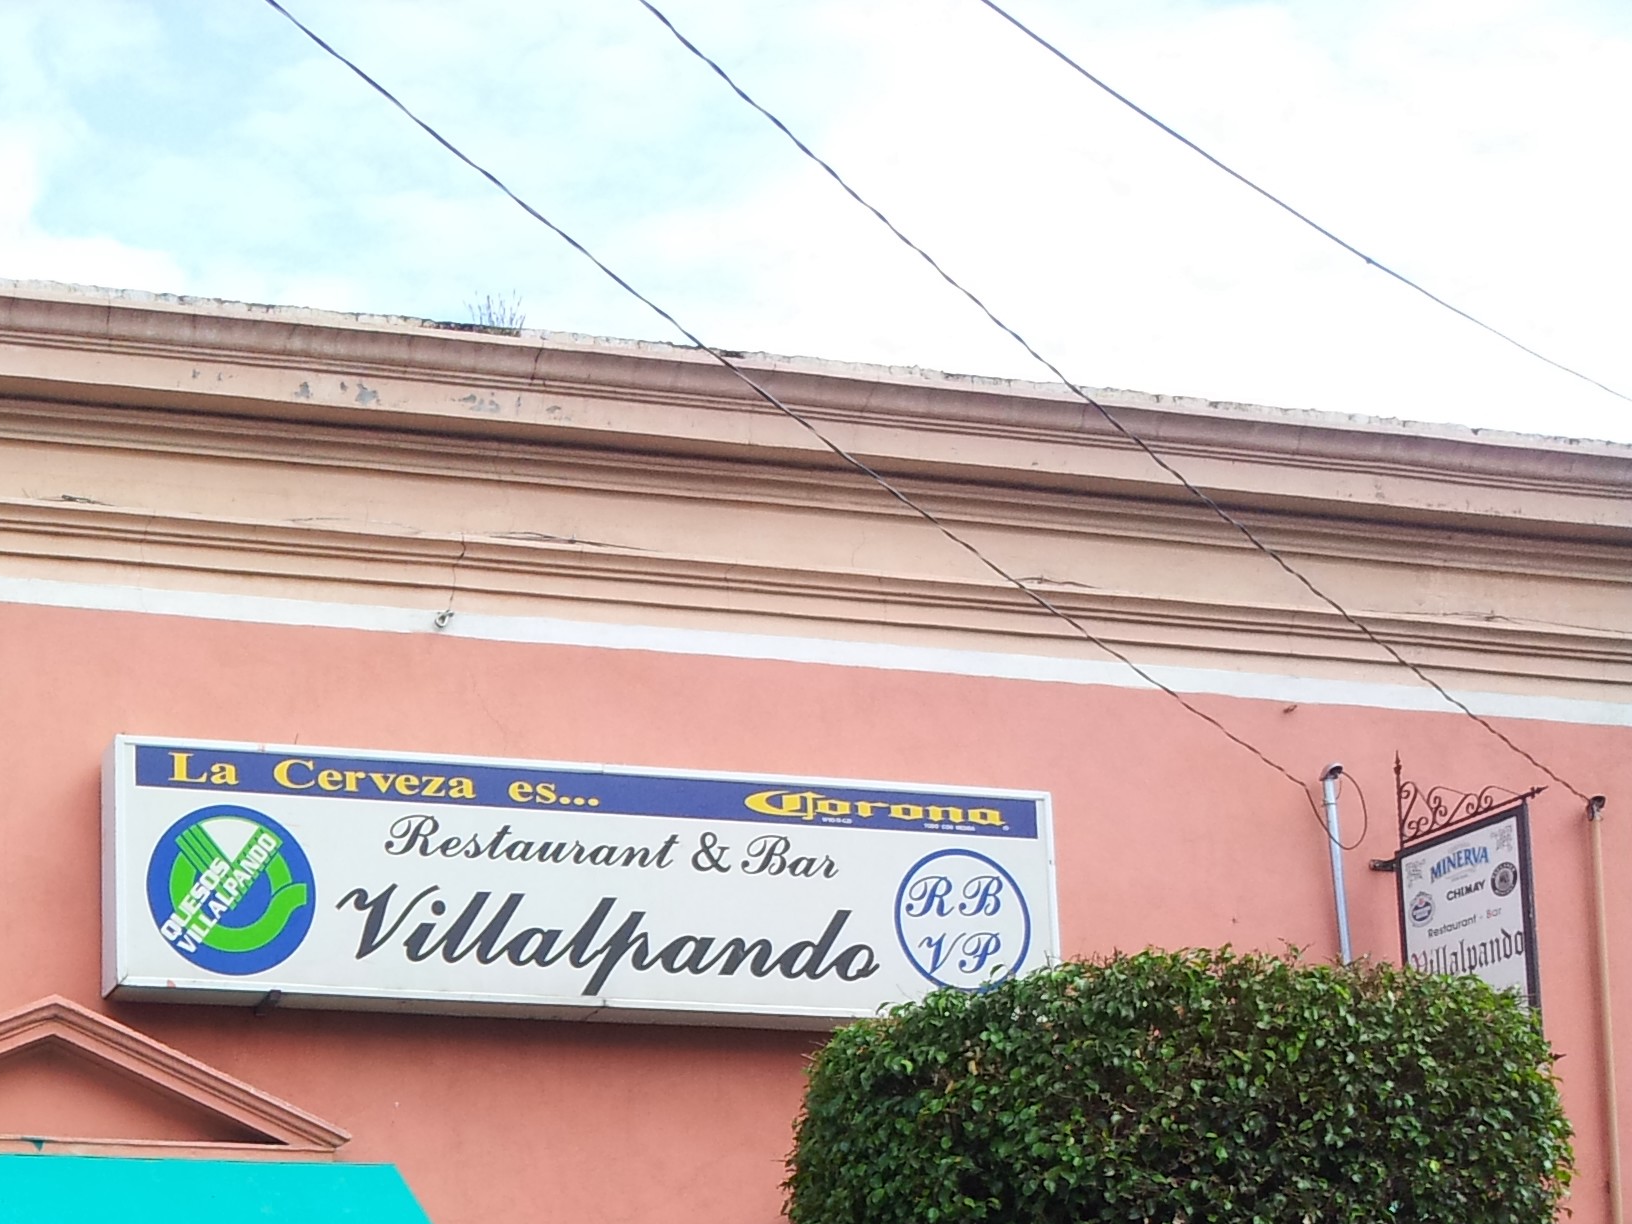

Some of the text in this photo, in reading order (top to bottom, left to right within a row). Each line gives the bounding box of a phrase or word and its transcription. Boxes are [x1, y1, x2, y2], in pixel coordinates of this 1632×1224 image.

[169, 752, 600, 806] La Cerveza es...
[744, 790, 1006, 826] Corona
[384, 814, 840, 879] Restaurant & Bar
[1430, 846, 1489, 883] MINERVA
[160, 857, 230, 941] QUESOS
[176, 832, 277, 953] VILLALPANDO
[1446, 880, 1486, 901] CHIMAY
[335, 883, 881, 996] Villalpando
[1428, 914, 1476, 938] Restaurant
[1486, 908, 1502, 919] Bar
[1411, 927, 1524, 978] Villalpando
